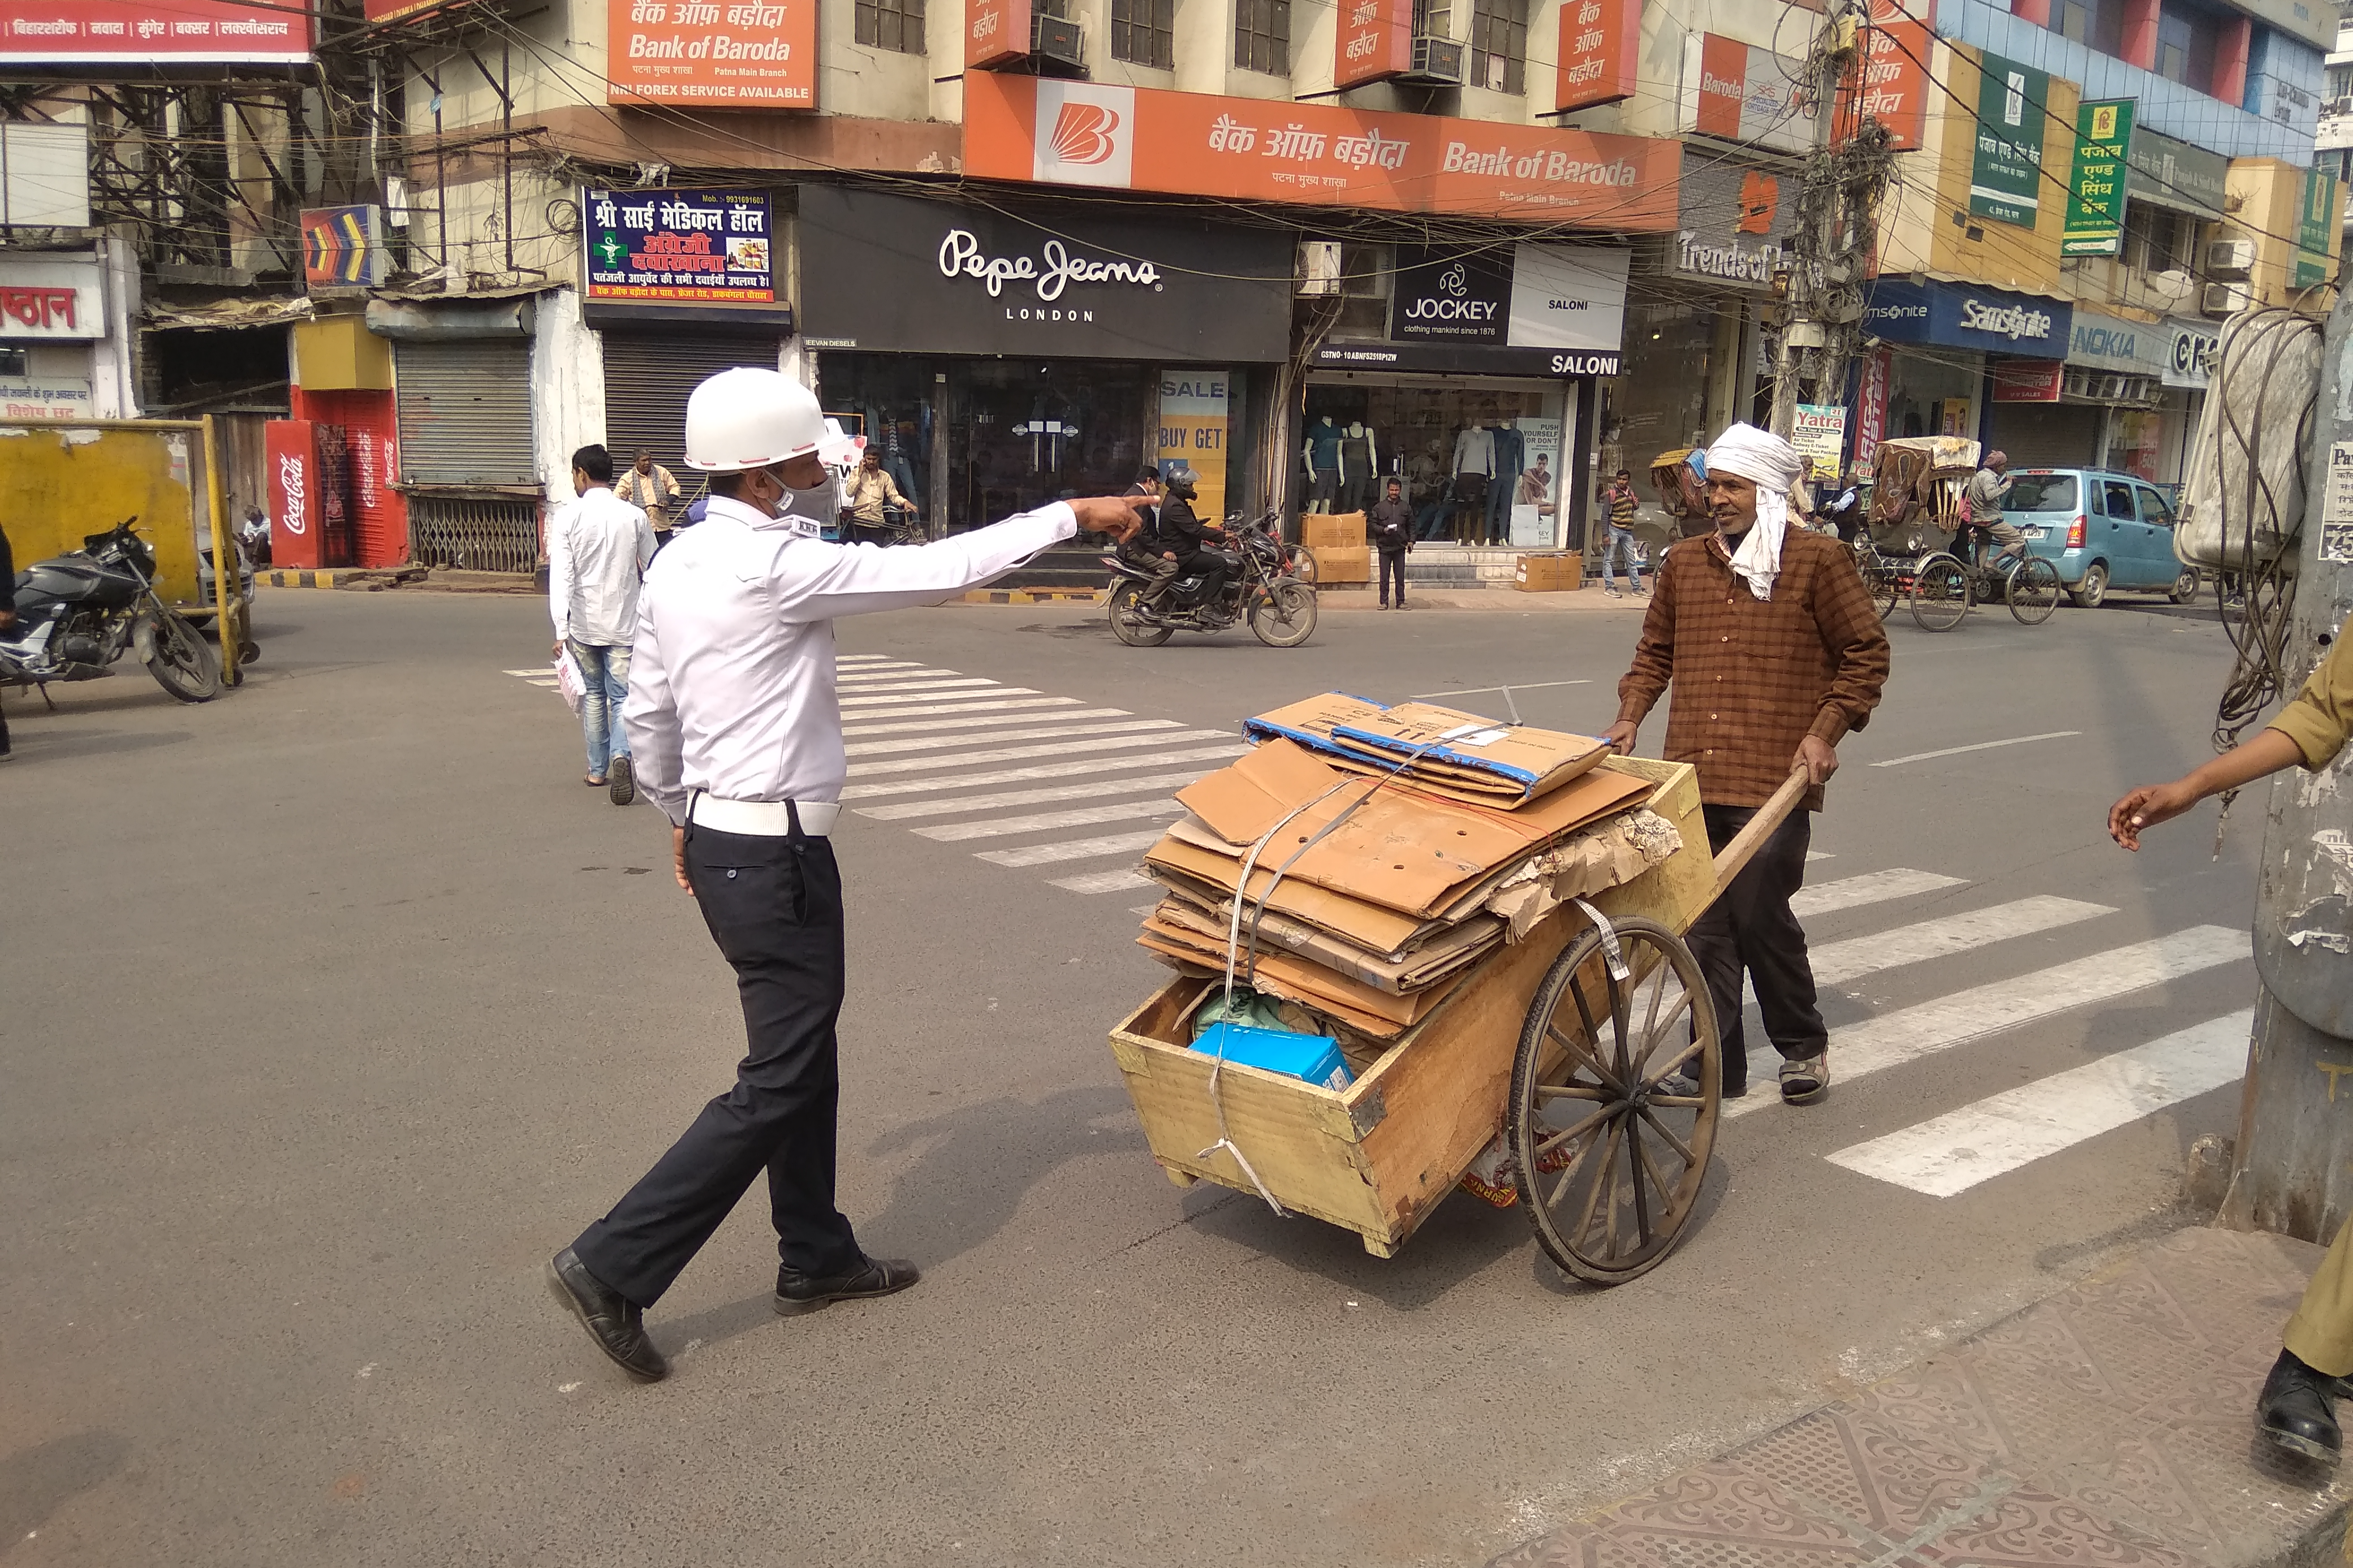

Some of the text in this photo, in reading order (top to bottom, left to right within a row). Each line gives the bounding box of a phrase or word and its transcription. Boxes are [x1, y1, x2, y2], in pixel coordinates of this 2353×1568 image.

[1578, 0, 1601, 25] बैंक
[90, 22, 124, 34] नवादा
[629, 34, 790, 61] Bank of Baroda
[632, 66, 693, 77] पटना मुख्य शाखा
[714, 67, 787, 77] Patna Main Branch
[610, 85, 809, 99] NRI FOREX SERVICE AVAILABLE
[1703, 72, 1742, 100] Baroda
[1209, 114, 1257, 154] बैंक
[1334, 127, 1411, 171] बड़ौदा
[1979, 131, 1997, 155] पंजाब
[1443, 142, 1637, 187] Bank of Baroda
[2083, 165, 2115, 180] एण्ड
[1272, 172, 1347, 188] पटना मुख्य शाखा
[595, 200, 617, 227] श्री
[660, 202, 723, 231] मेडिकल
[729, 204, 764, 232] हॉल
[643, 232, 712, 254] अंग्रेजी
[630, 253, 726, 272] दवाखाना
[1678, 230, 1748, 278] Trends
[940, 230, 1160, 301] Pepe Jeans
[593, 271, 626, 283] पतंजली
[660, 273, 673, 284] की
[675, 273, 693, 284] सभी
[1006, 308, 1093, 322] LONDON
[1406, 299, 1497, 320] JOCKEY
[1548, 300, 1588, 310] SALONI
[1404, 325, 1430, 334] clothing
[2072, 326, 2136, 360] NOKIA
[1551, 355, 1618, 375] SALONI
[1161, 381, 1225, 398] SALE
[1798, 412, 1842, 428] Yatra
[1160, 427, 1222, 449] BUY GET
